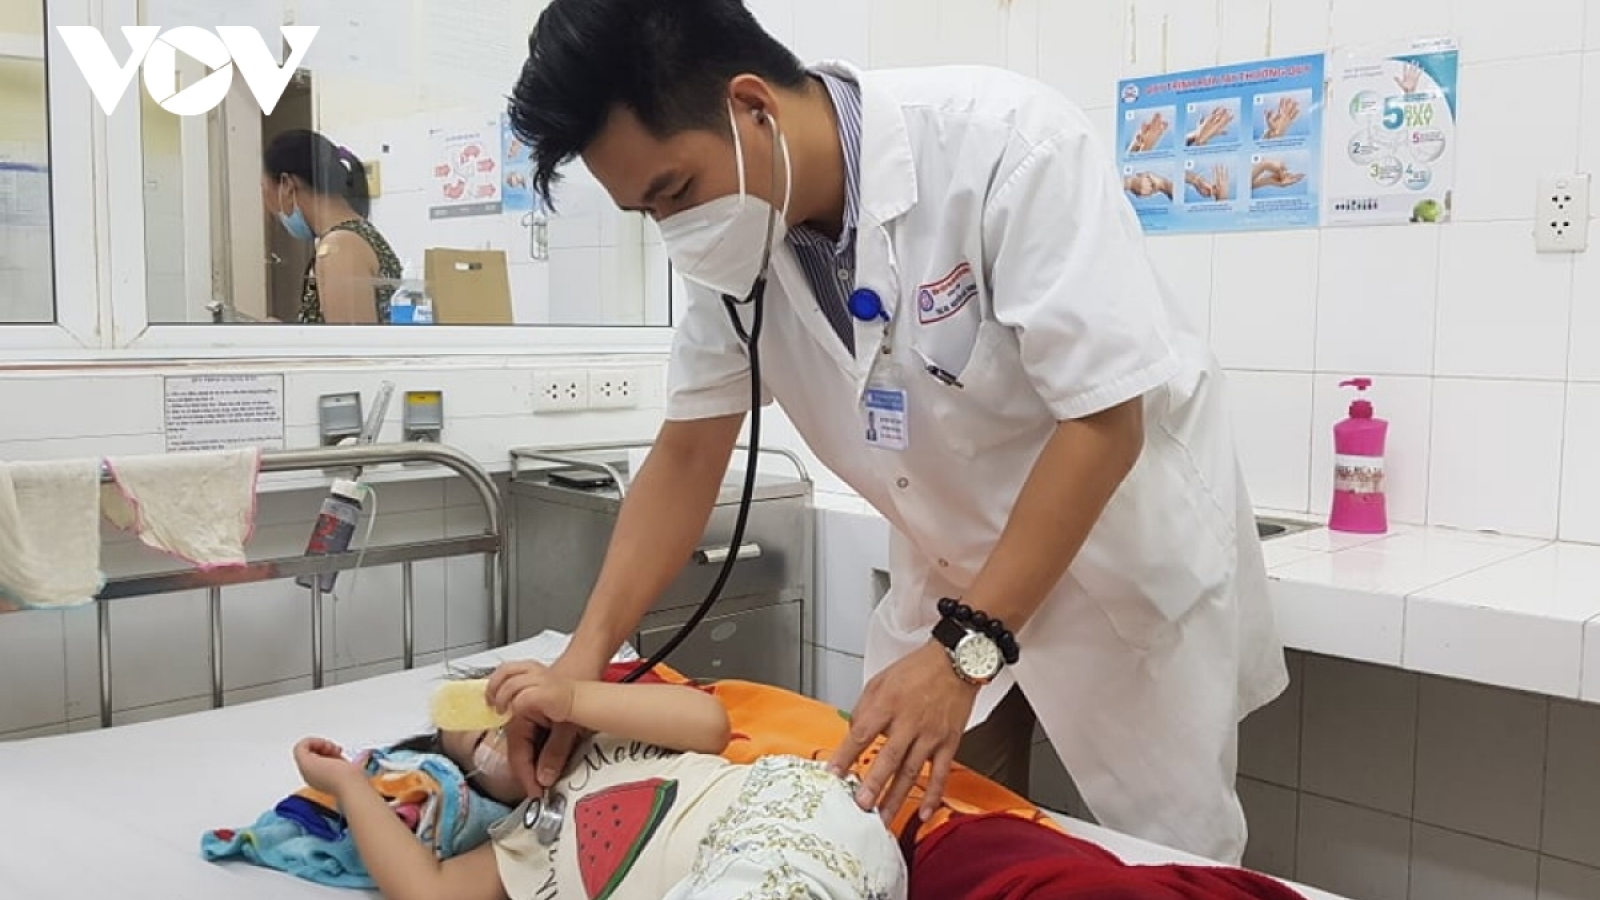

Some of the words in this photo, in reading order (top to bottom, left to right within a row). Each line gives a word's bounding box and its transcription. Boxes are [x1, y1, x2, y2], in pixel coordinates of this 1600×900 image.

[1383, 97, 1404, 130] 5
[1352, 142, 1361, 154] 2
[1370, 165, 1379, 178] 3
